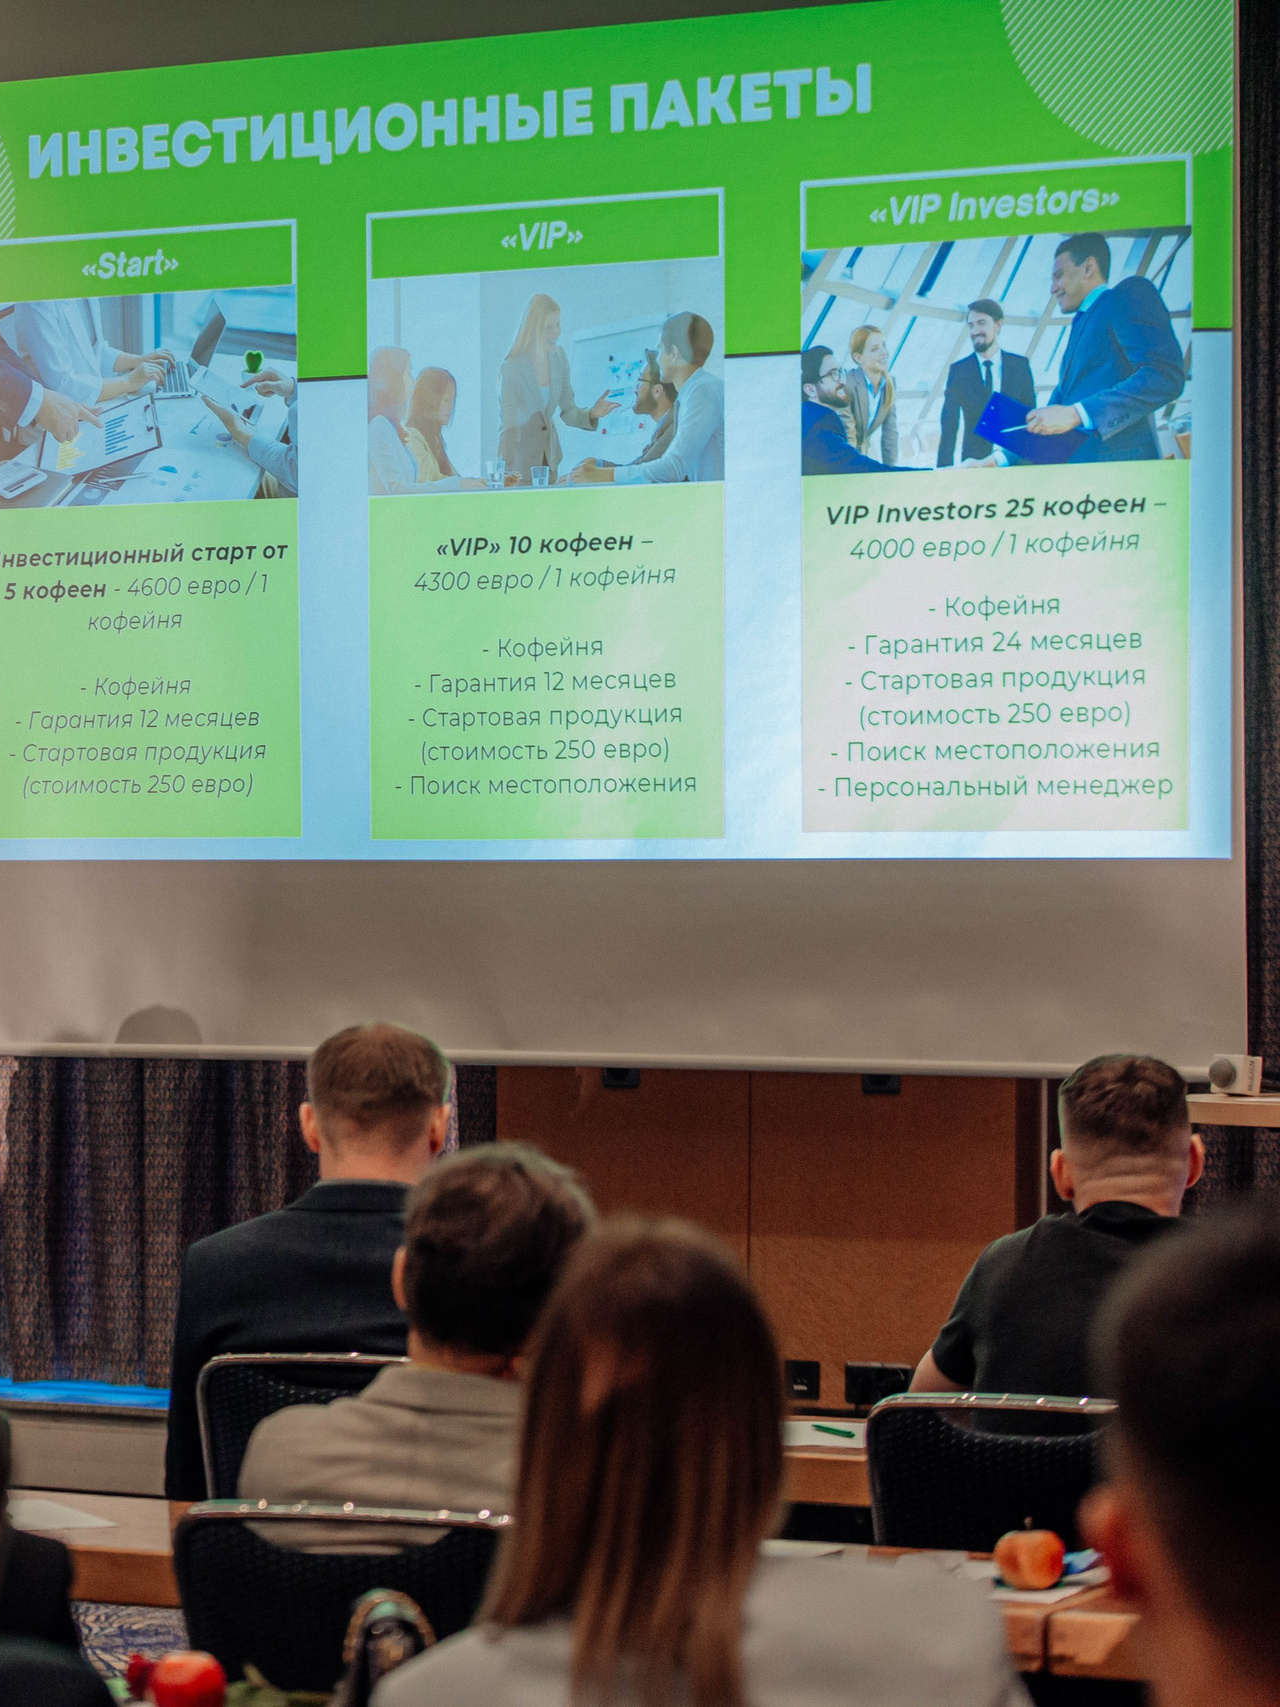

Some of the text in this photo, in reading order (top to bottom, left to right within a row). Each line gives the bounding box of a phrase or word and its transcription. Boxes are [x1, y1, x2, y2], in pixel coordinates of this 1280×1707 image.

[29, 63, 871, 178] ИНВЕСТИЦИОННЫЕ ПАКЕТЫ
[870, 187, 1119, 225] «VIP Investors»
[501, 221, 583, 250] «VIP»
[82, 249, 178, 278] «Start»
[827, 505, 869, 525] VIP
[877, 502, 996, 523] Investors
[1005, 498, 1035, 518] 25
[1043, 494, 1146, 519] кофеен
[192, 546, 256, 564] старт
[263, 545, 288, 559] от
[437, 538, 500, 556] «VIP»
[510, 536, 532, 554] 10
[540, 533, 633, 556] кофеен
[850, 538, 914, 559] 4000
[923, 540, 986, 561] евро
[1025, 532, 1140, 557] кофейня
[4, 583, 16, 600] 5
[23, 580, 106, 602] кофеен
[127, 577, 181, 596] 4600
[188, 579, 240, 599] евро
[414, 571, 470, 591] 4300
[477, 574, 533, 594] евро
[570, 565, 675, 591] кофейня
[946, 595, 1060, 621] Кофейня
[88, 611, 182, 634] кофейня
[499, 637, 603, 662] Кофейня
[866, 635, 983, 659] Гарантия
[993, 631, 1022, 652] 24
[1031, 632, 1142, 652] месяцев
[95, 677, 191, 700] Кофейня
[430, 674, 535, 697] Гарантия
[544, 671, 564, 691] 12
[573, 673, 676, 692] месяцев
[861, 671, 993, 694] Стартовая
[1002, 669, 1145, 692] продукция
[29, 711, 132, 733] Гарантия
[140, 709, 158, 728] 12
[165, 712, 259, 729] месяцев
[423, 708, 540, 731] Стартовая
[550, 707, 682, 730] продукция
[860, 701, 1130, 731] (стоимость 250 евро)
[23, 744, 137, 766] Стартовая
[145, 745, 266, 765] продукция
[422, 738, 668, 765] (стоимость 250 евро)
[848, 742, 926, 761] Поиск
[936, 742, 1159, 760] местоположения
[23, 774, 253, 799] (стоимость 250 евро)
[411, 776, 480, 795] Поиск
[489, 777, 696, 794] местоположения
[835, 776, 1027, 802] Персональный
[1038, 779, 1173, 799] менеджер
